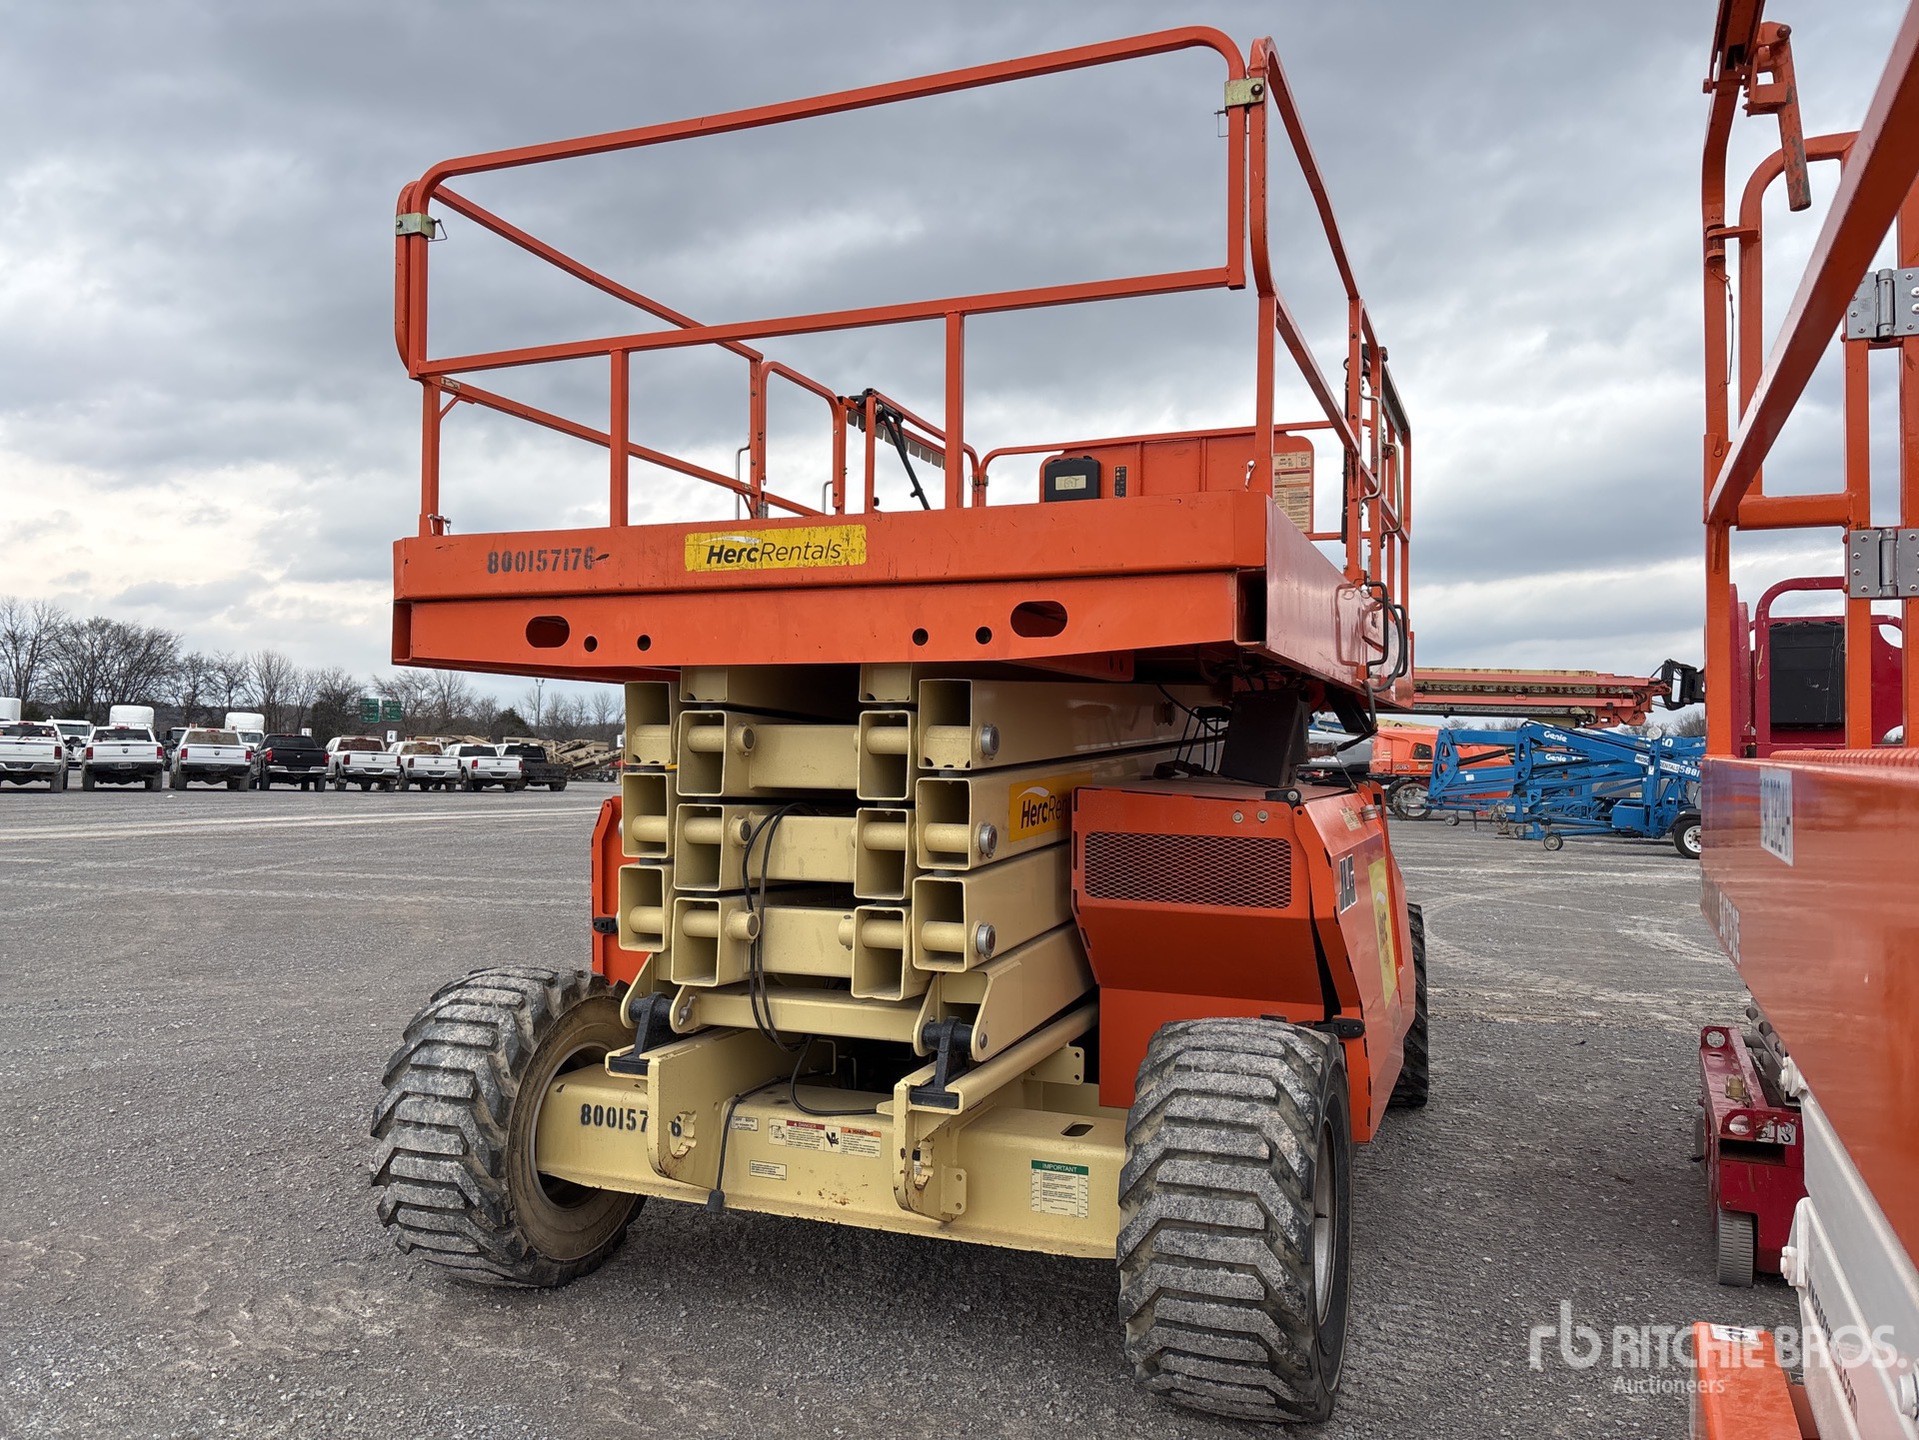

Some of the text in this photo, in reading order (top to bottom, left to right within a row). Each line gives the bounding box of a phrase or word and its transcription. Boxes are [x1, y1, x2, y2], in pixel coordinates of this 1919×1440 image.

[487, 546, 595, 573] 800157176
[706, 539, 842, 566] HercRentals
[1543, 730, 1568, 743] Genie
[1545, 753, 1567, 763] Genie
[1338, 853, 1358, 915] JLG
[1042, 1163, 1078, 1173] IMPORTANT
